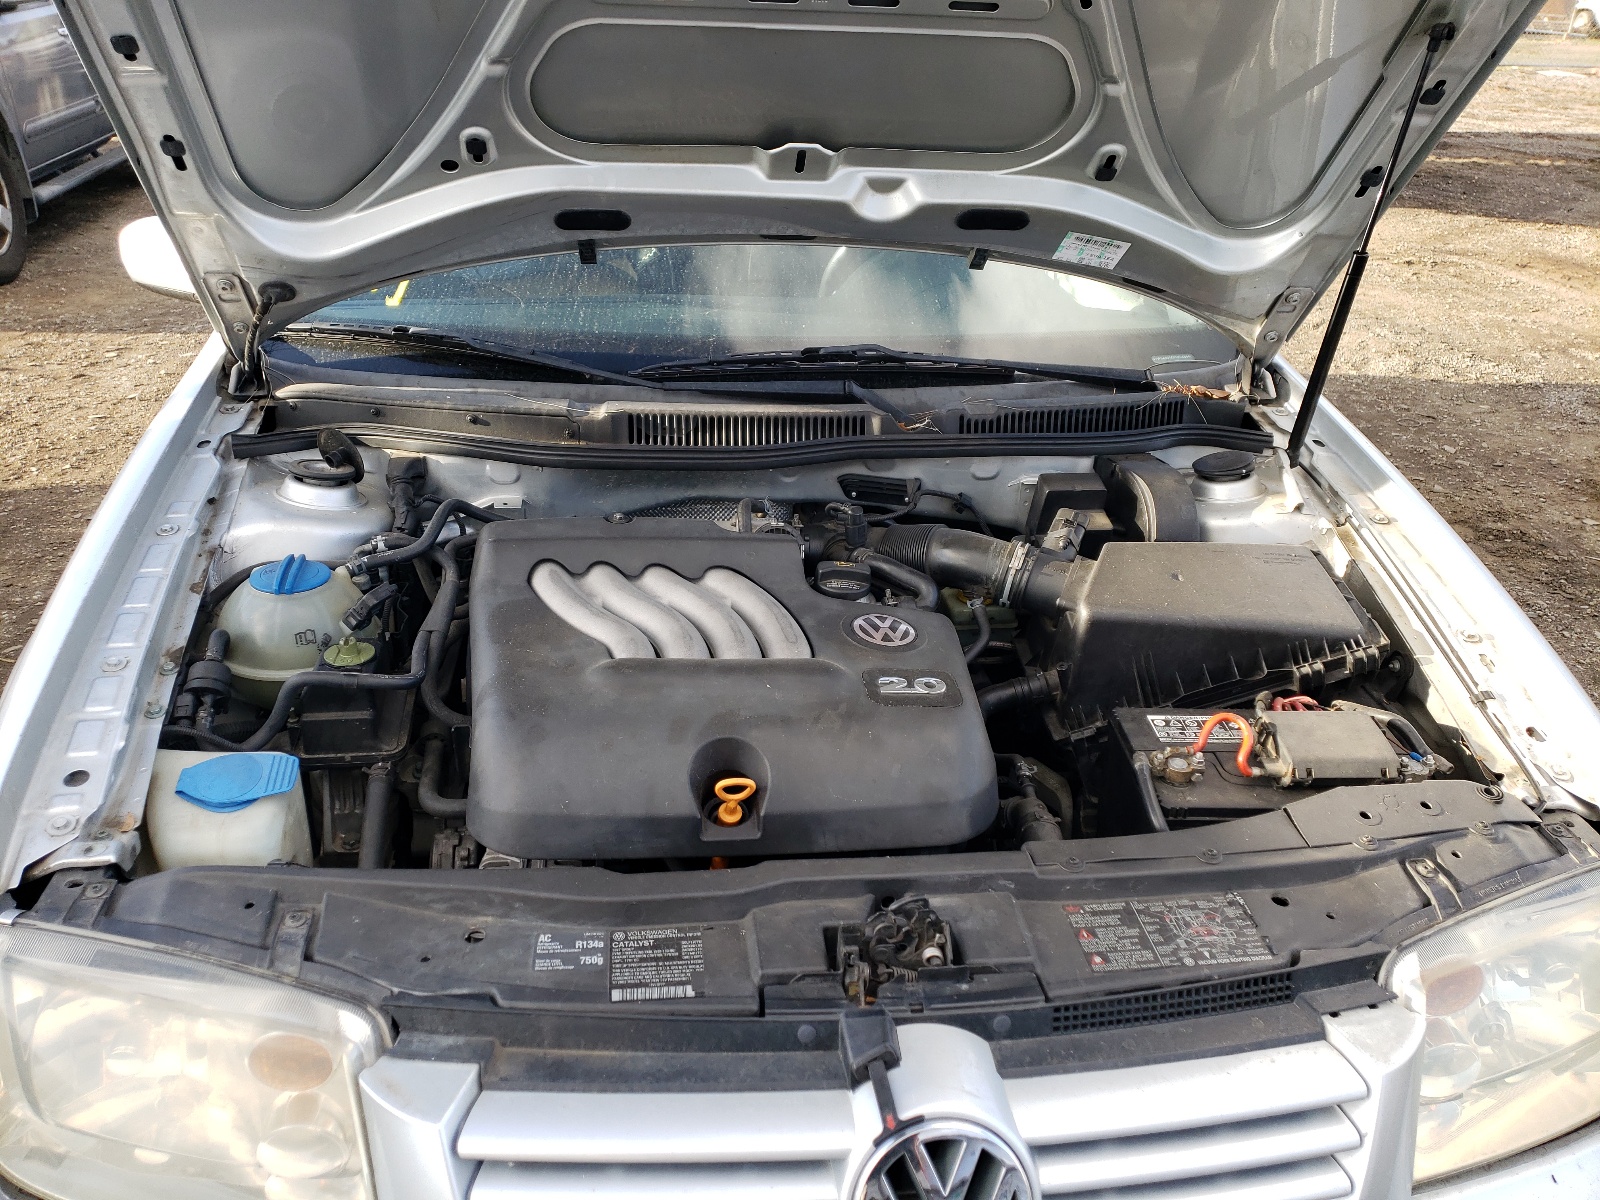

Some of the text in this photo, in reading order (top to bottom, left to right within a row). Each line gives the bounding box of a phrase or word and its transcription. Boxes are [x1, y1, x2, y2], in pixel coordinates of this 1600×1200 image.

[627, 929, 678, 937] VOLKSWAGEN
[538, 934, 552, 943] AC
[576, 940, 604, 949] R134a
[612, 940, 655, 948] CATALYST
[580, 956, 604, 966] 750g
